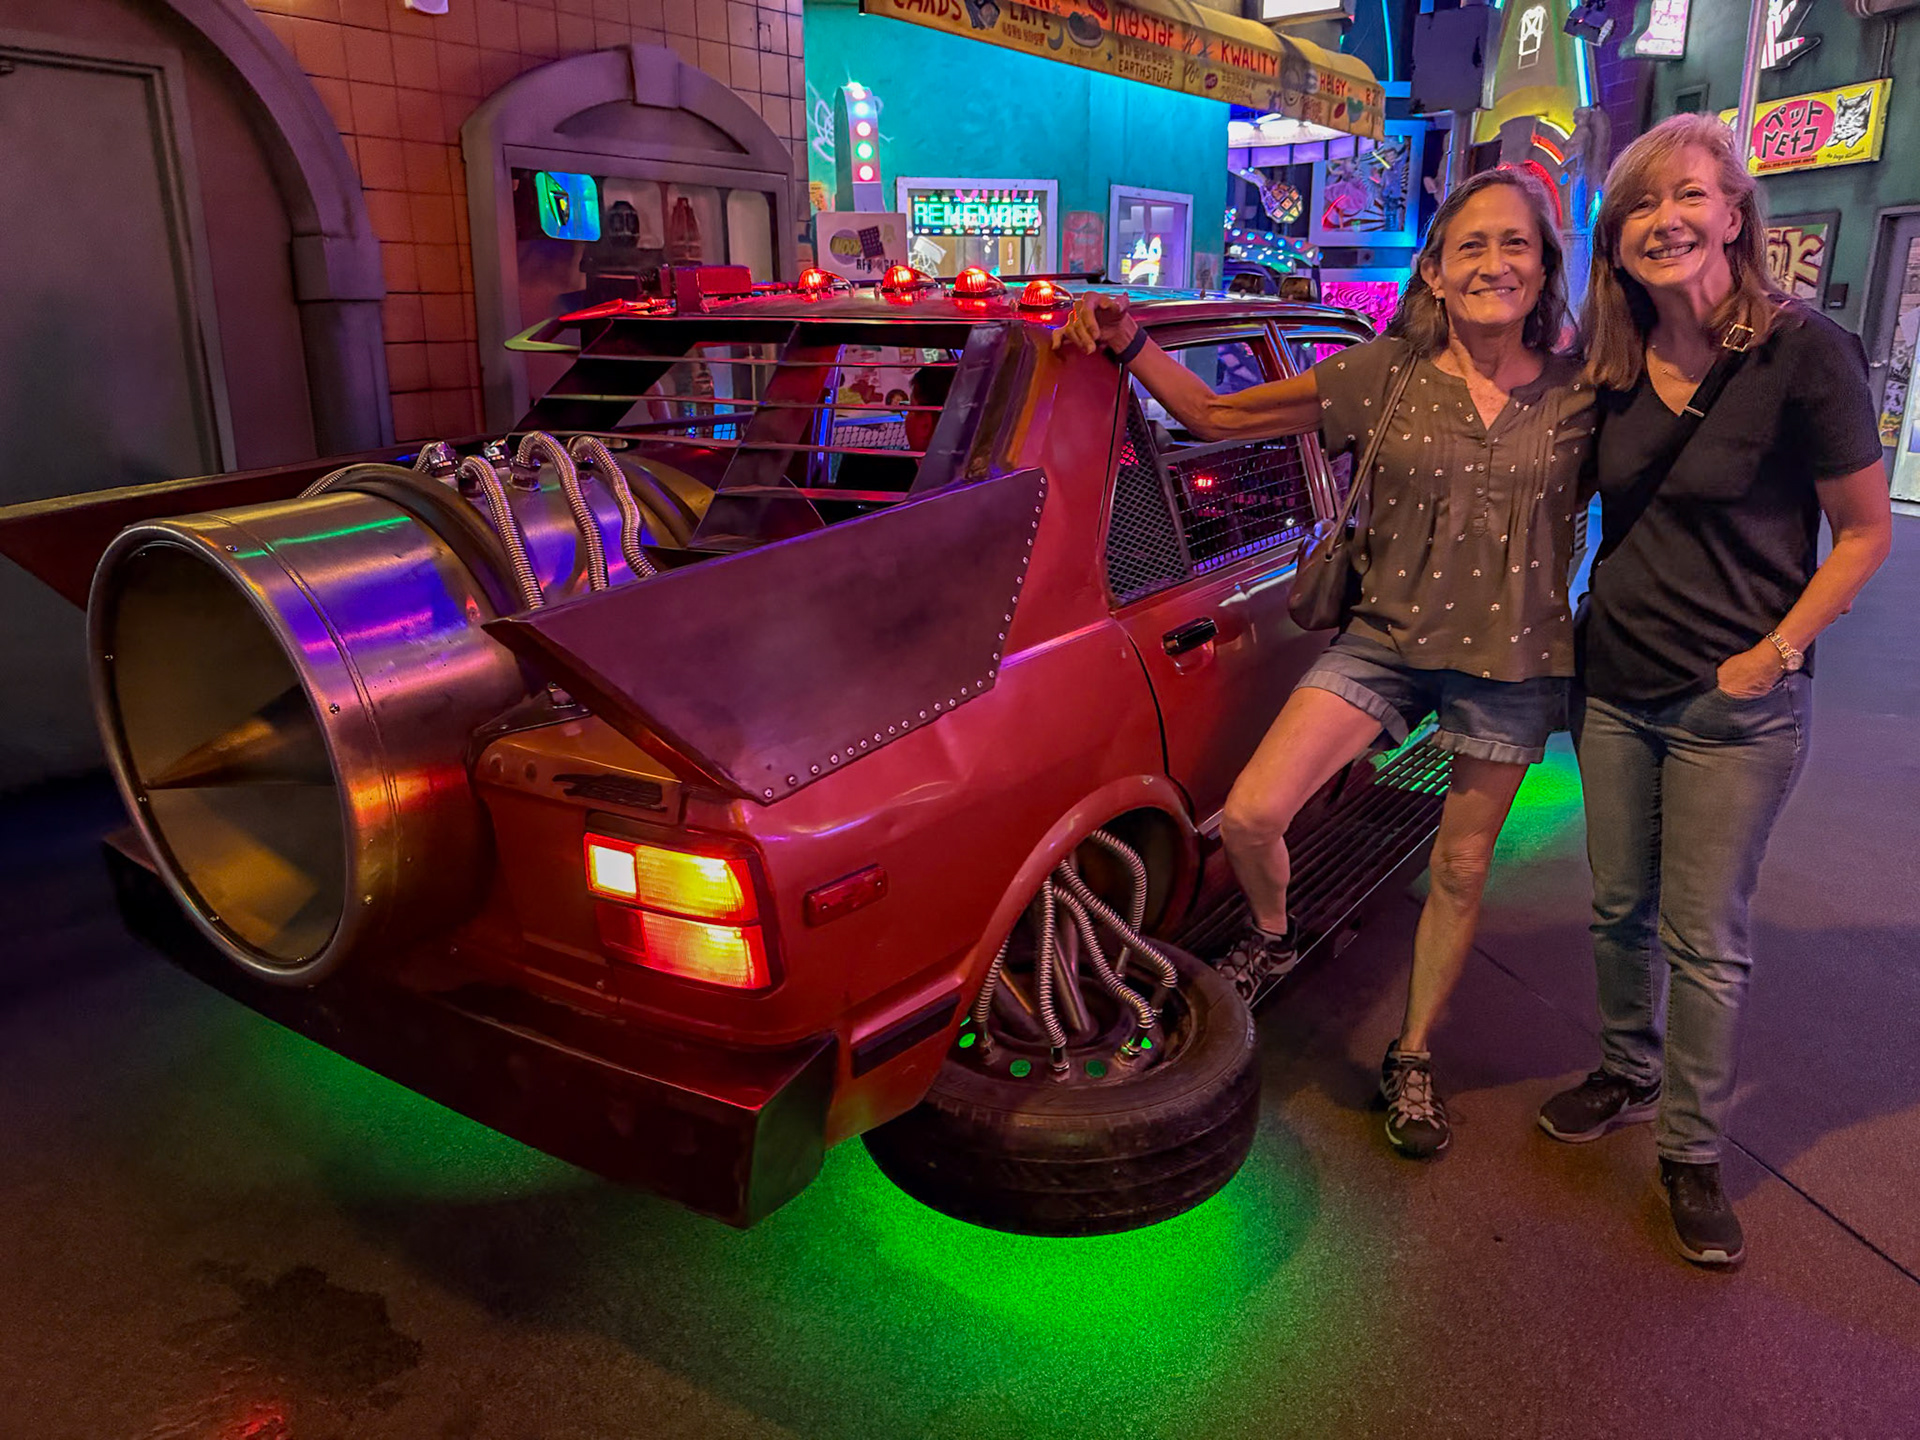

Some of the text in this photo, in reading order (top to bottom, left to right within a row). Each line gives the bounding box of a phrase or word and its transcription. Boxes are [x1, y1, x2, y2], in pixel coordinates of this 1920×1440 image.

[1009, 3, 1051, 30] LATE
[1117, 59, 1173, 85] EARTHSTUFF
[1221, 40, 1278, 77] KWALITY
[1764, 100, 1824, 128] ペット
[914, 203, 1039, 227] REMEMBER
